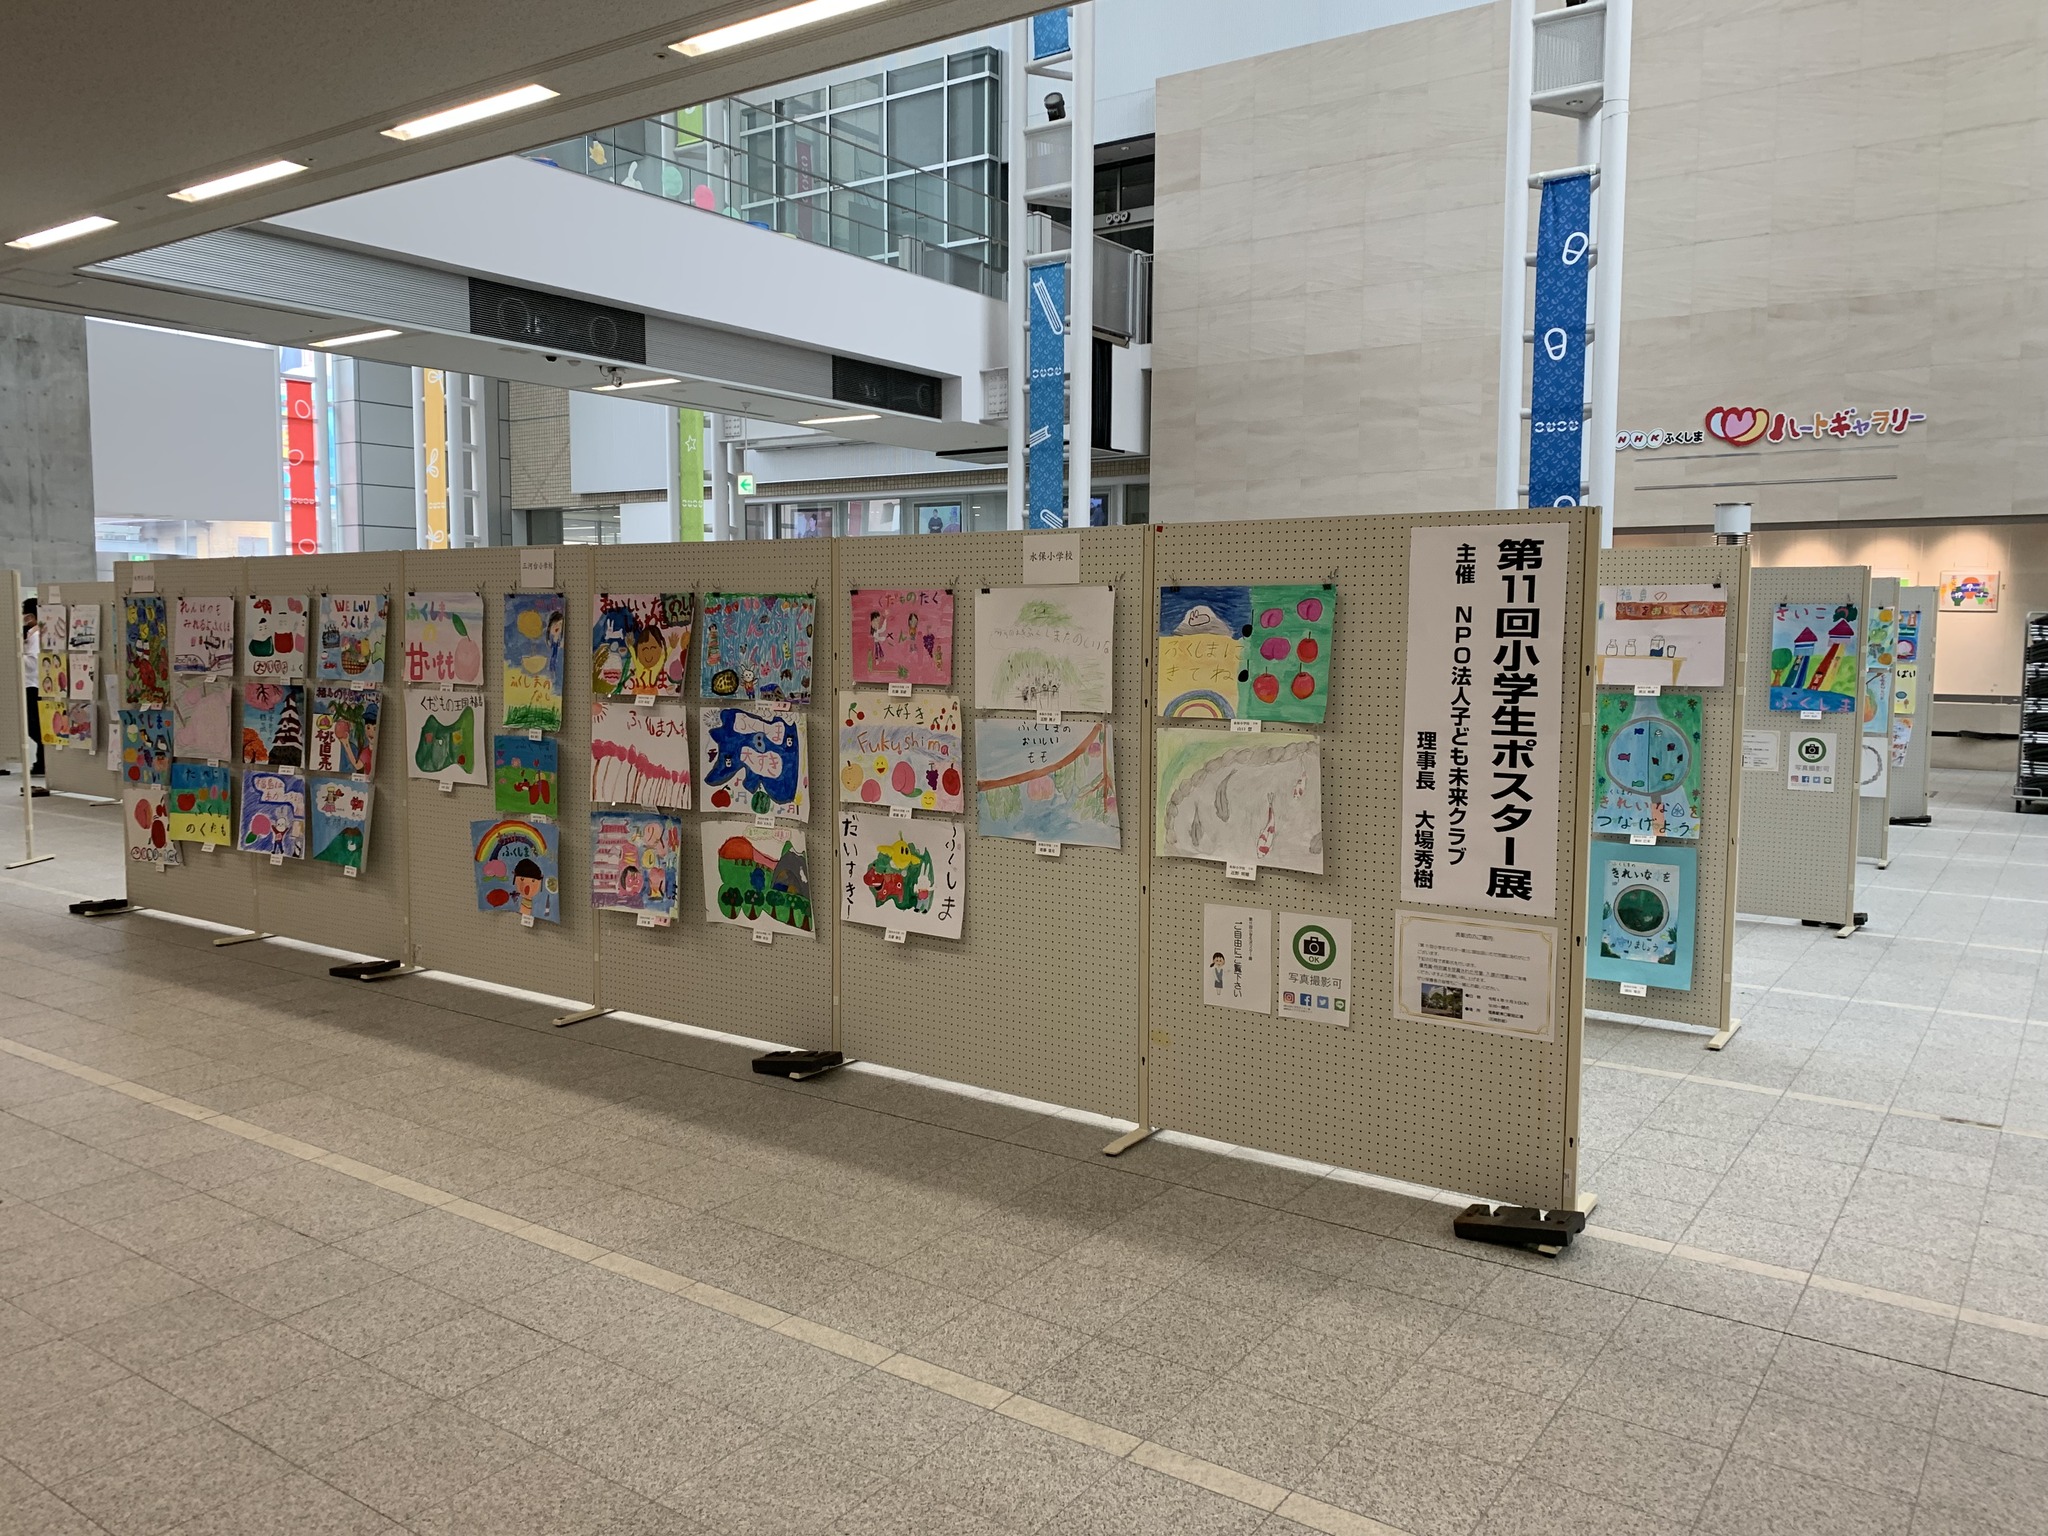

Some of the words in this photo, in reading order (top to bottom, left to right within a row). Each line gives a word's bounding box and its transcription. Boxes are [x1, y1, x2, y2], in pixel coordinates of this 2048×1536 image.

[1768, 409, 1925, 441] ハートギャラリー
[1664, 431, 1703, 444] ふくしま
[1455, 543, 1476, 584] 主催
[334, 600, 350, 612] WE
[405, 641, 455, 680] 甘いもも
[1164, 640, 1246, 660] ふくしまに
[1165, 664, 1234, 682] きてね
[883, 702, 925, 726] 大好き
[1775, 697, 1851, 713] ふくしま
[1486, 538, 1545, 901] 第11回小学生ポスター展
[857, 729, 950, 757] Fukushima
[1022, 737, 1059, 746] おいしい
[1447, 606, 1473, 866] NPO法人子ども未来クラブ
[741, 748, 779, 777] 大すき
[1416, 731, 1437, 790] 理事長
[1597, 815, 1690, 837] つなげよう
[502, 846, 531, 858] ふくしま
[1413, 810, 1435, 889] 大場秀樹
[1233, 921, 1243, 998] ご自由にご覧下さい
[1308, 955, 1320, 964] OK
[1288, 972, 1342, 990] 写真撮影可
